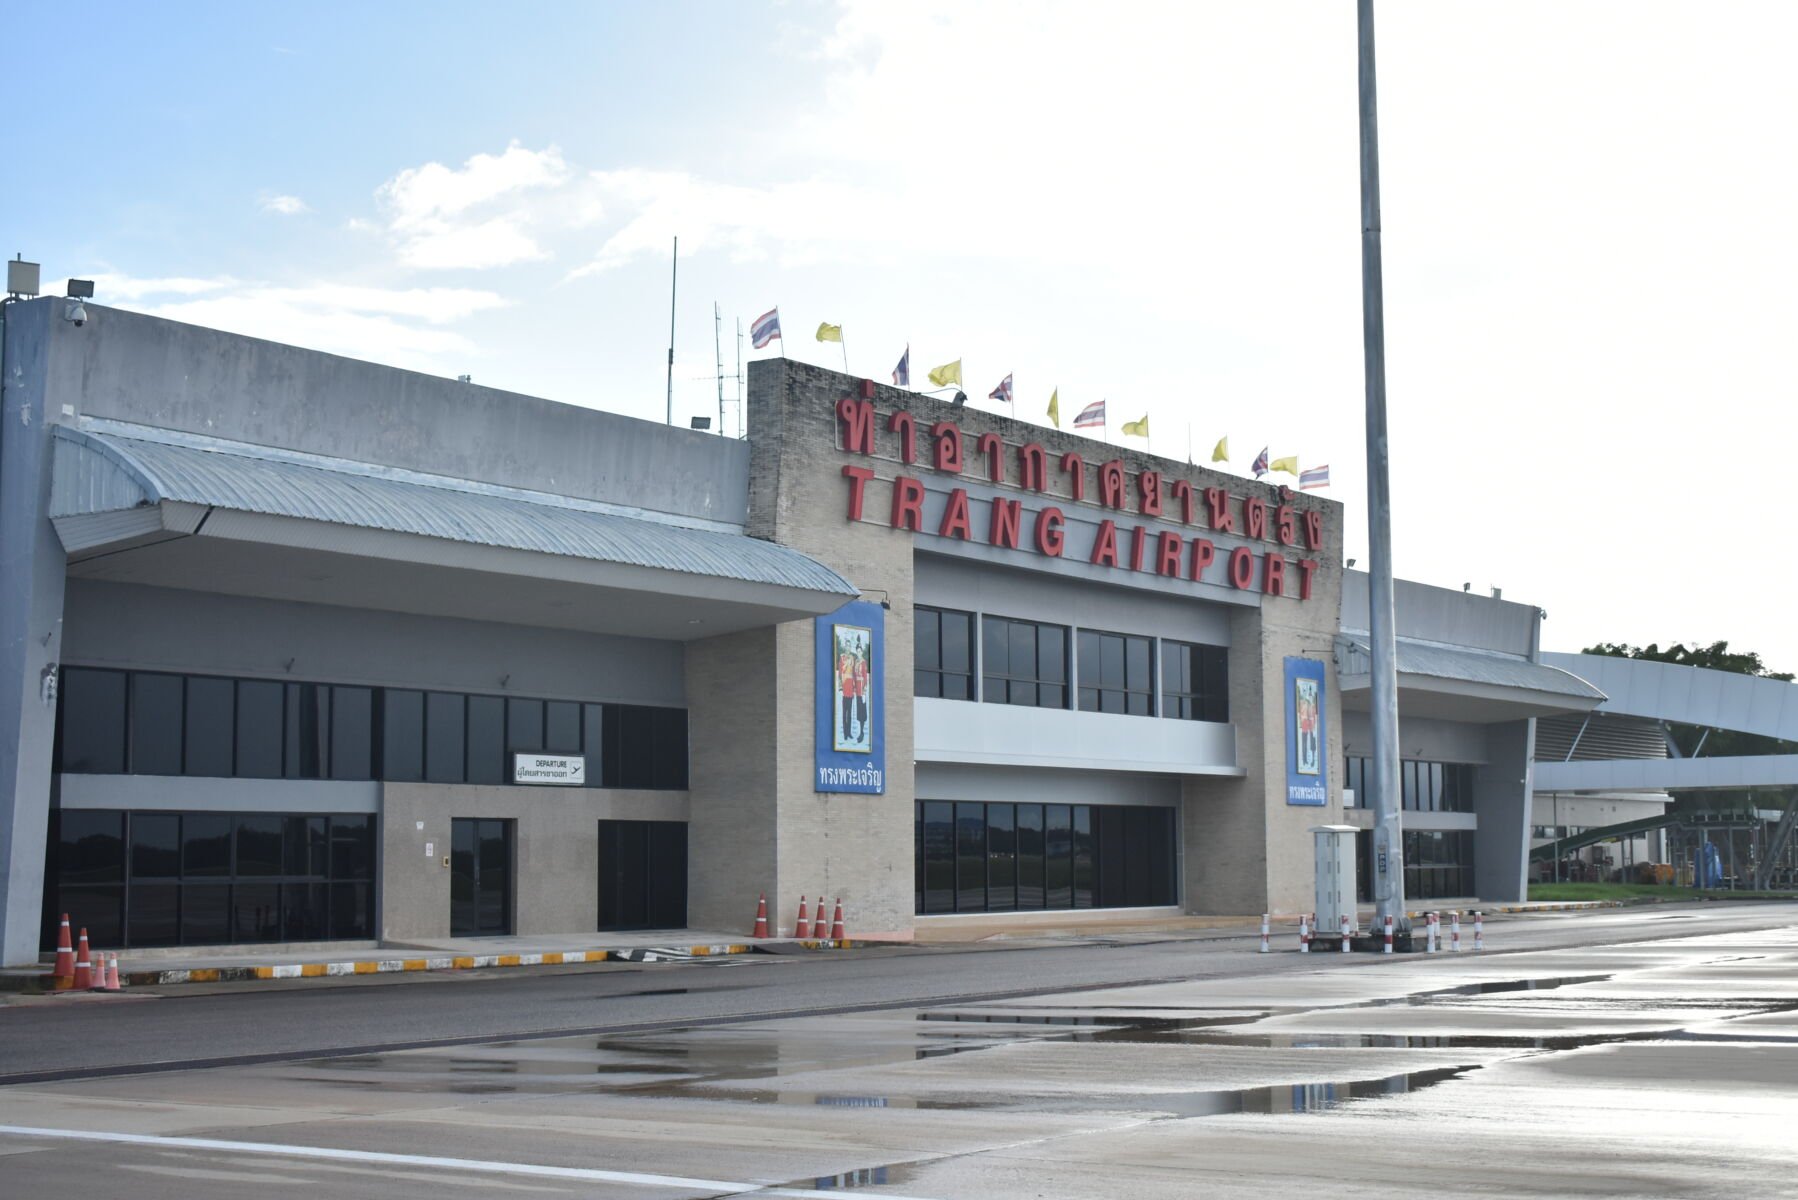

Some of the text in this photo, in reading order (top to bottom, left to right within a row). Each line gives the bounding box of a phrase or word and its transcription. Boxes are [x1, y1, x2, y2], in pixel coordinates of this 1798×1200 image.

[835, 378, 1323, 551] ท่าอากาศยานตรัง
[842, 465, 1319, 600] TRANG AIRPORT
[535, 759, 567, 768] DEPARTURE
[820, 762, 882, 793] ทรงพระเจริญ
